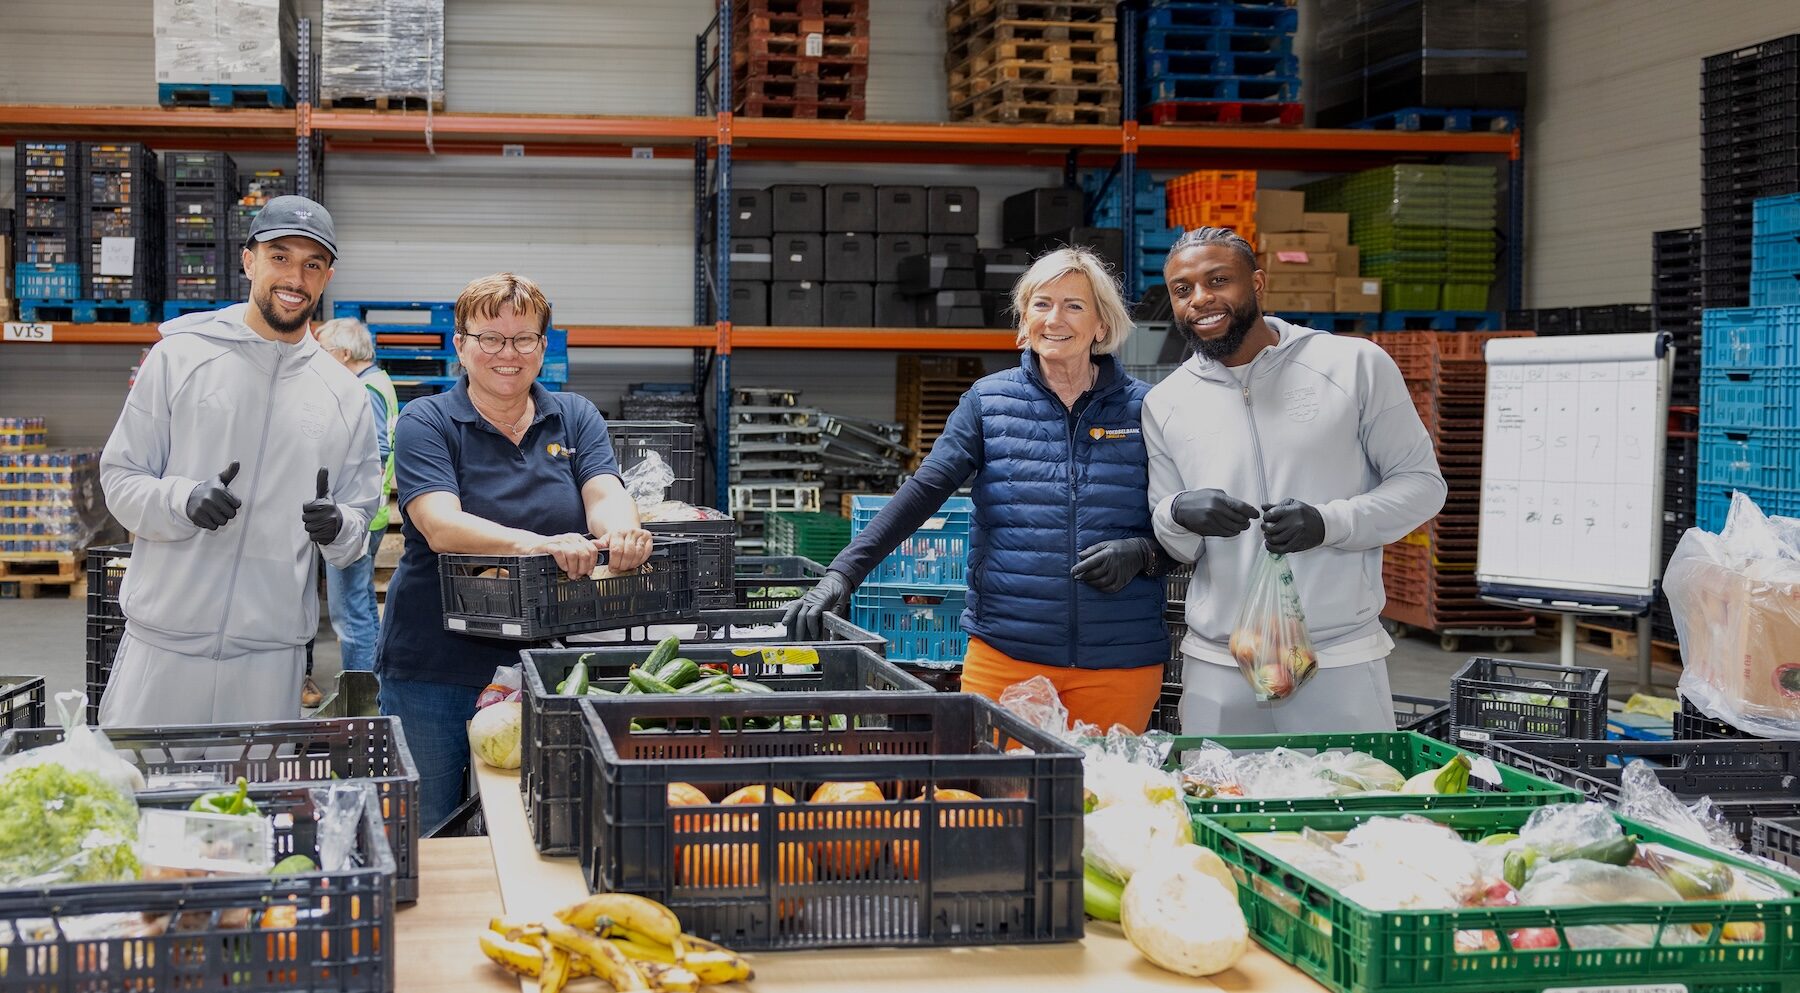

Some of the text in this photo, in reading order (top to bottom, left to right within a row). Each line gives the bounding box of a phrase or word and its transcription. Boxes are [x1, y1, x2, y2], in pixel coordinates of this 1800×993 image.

[13, 326, 44, 338] VIS
[1528, 435, 1545, 452] 3
[1553, 436, 1568, 448] 5
[1586, 435, 1601, 459] 7
